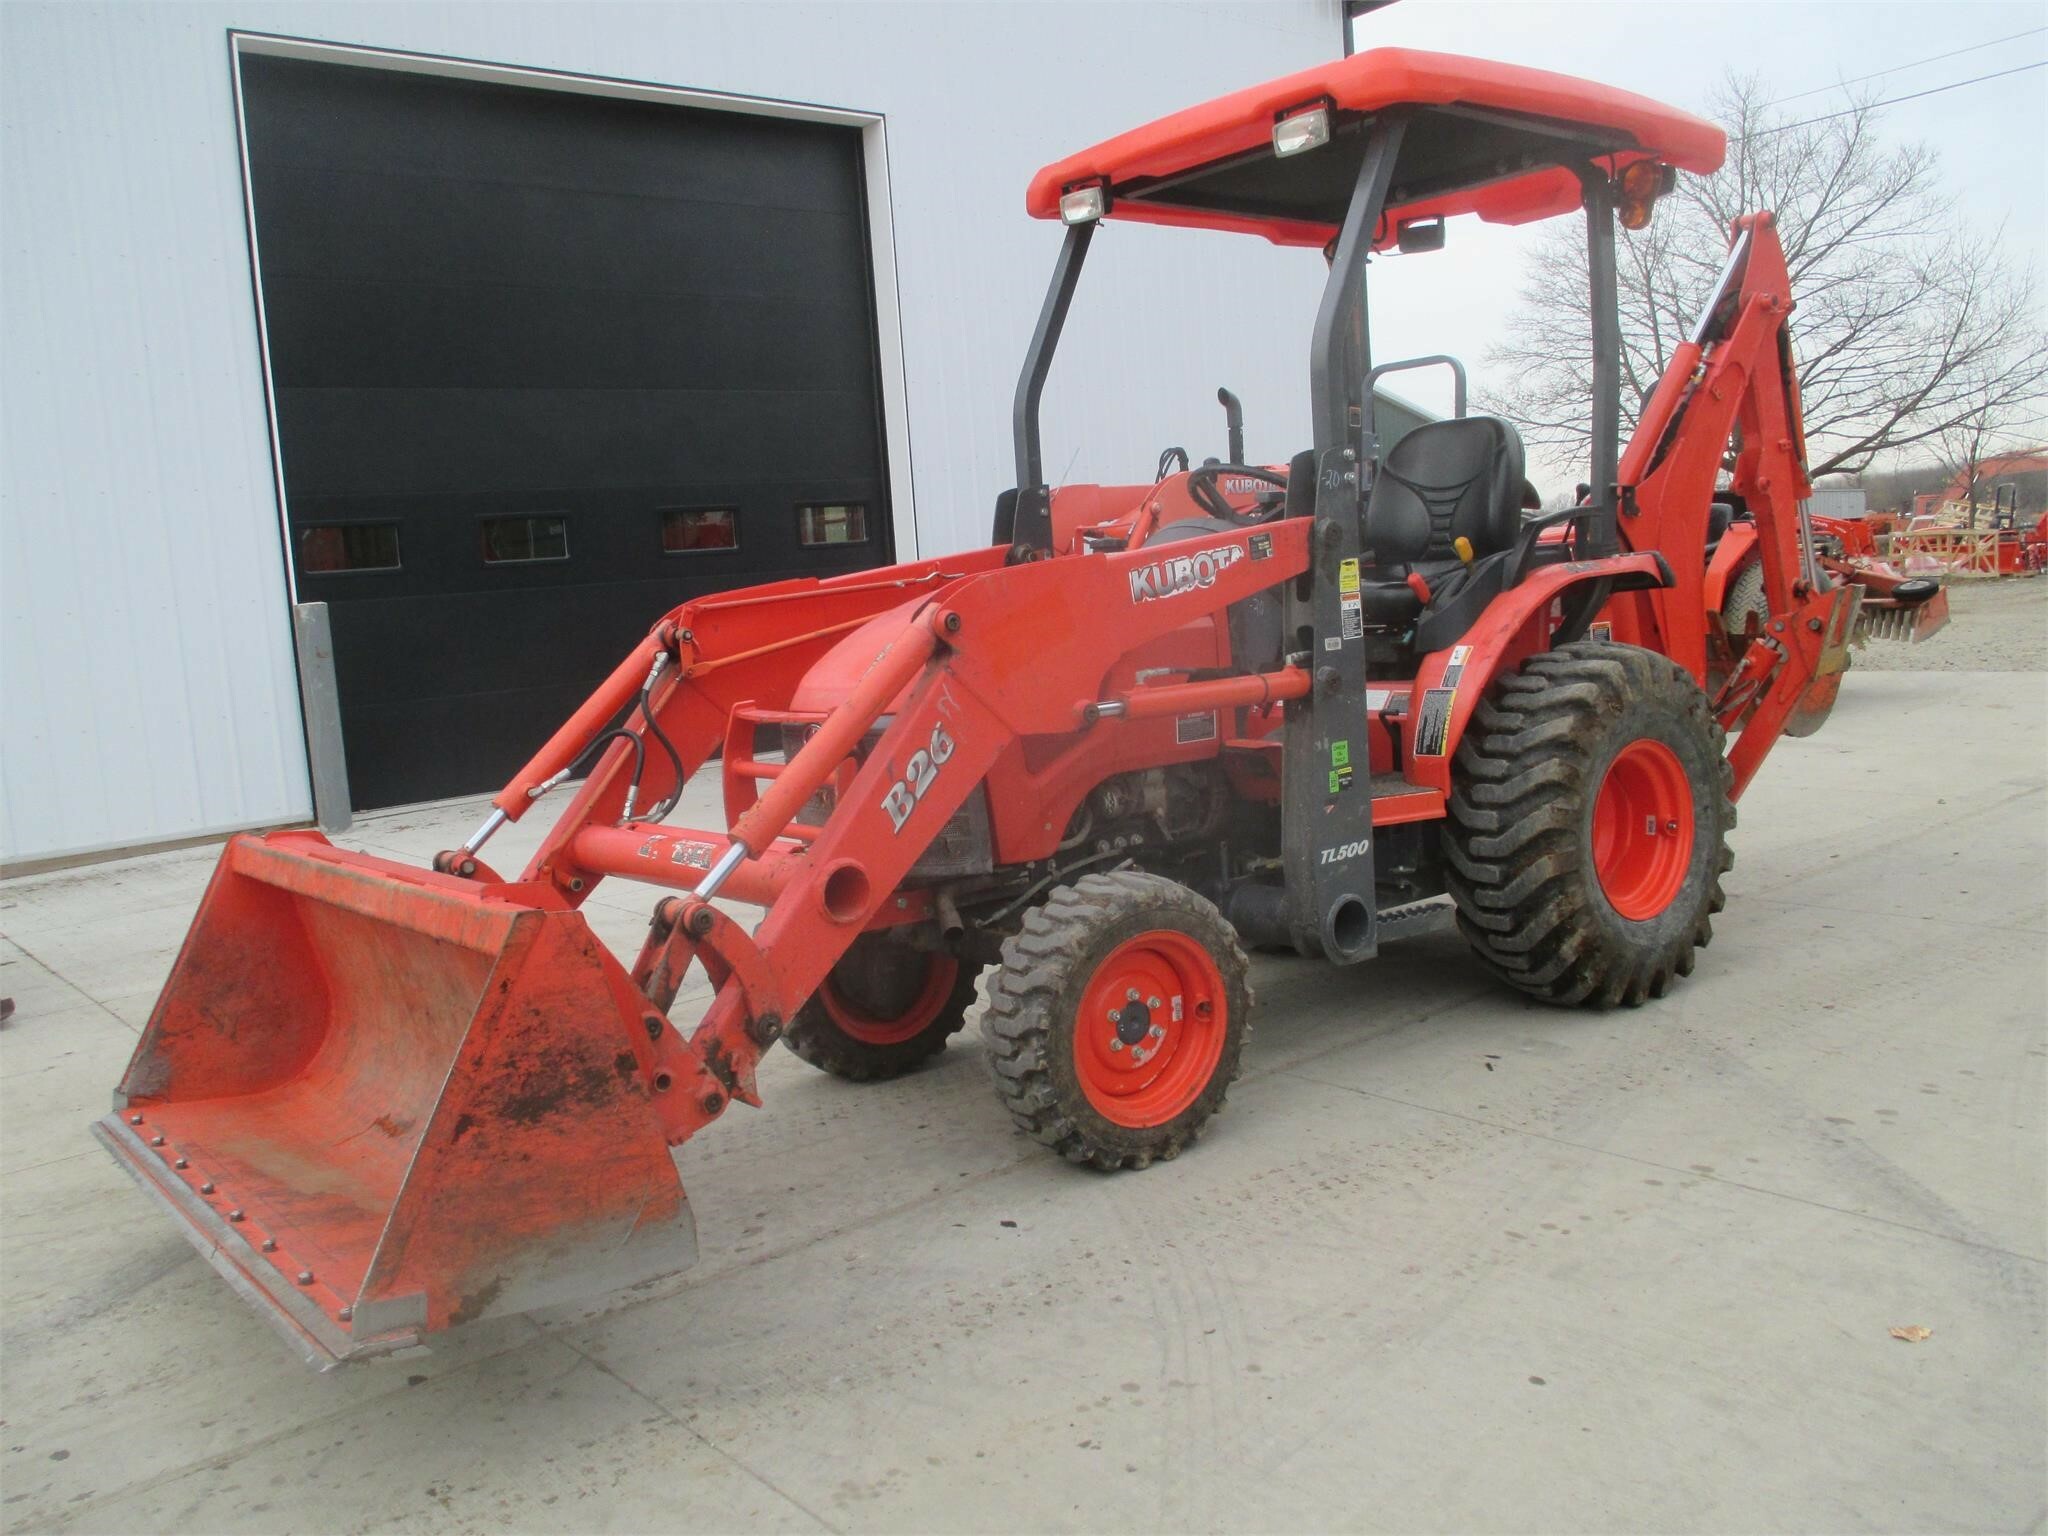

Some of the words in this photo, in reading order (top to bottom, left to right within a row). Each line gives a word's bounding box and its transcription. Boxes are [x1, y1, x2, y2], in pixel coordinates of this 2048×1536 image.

[1129, 545, 1243, 603] KUBOTA
[881, 721, 955, 834] B26
[1321, 839, 1369, 864] TL500
